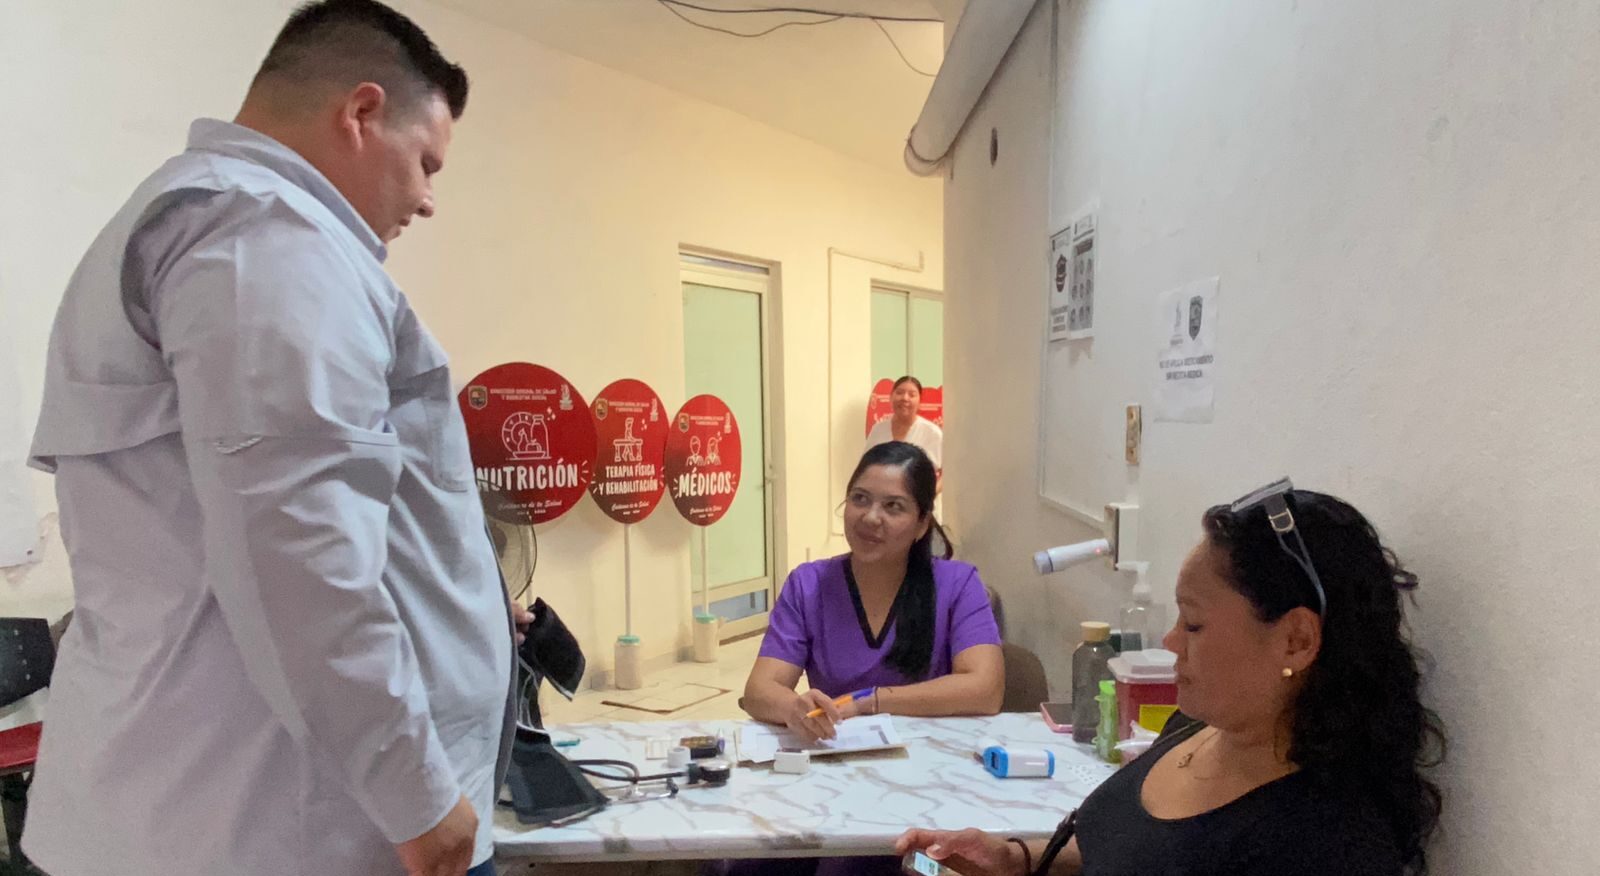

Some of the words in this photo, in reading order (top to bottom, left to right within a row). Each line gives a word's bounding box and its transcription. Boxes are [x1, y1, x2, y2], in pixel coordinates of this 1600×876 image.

[476, 458, 578, 491] NUTRICIÓN
[605, 465, 634, 478] TERAPIA
[634, 463, 655, 477] FÍSICA
[678, 467, 731, 497] MÉDICOS
[599, 483, 604, 495] Y
[605, 476, 658, 495] REHABILITACIÓN
